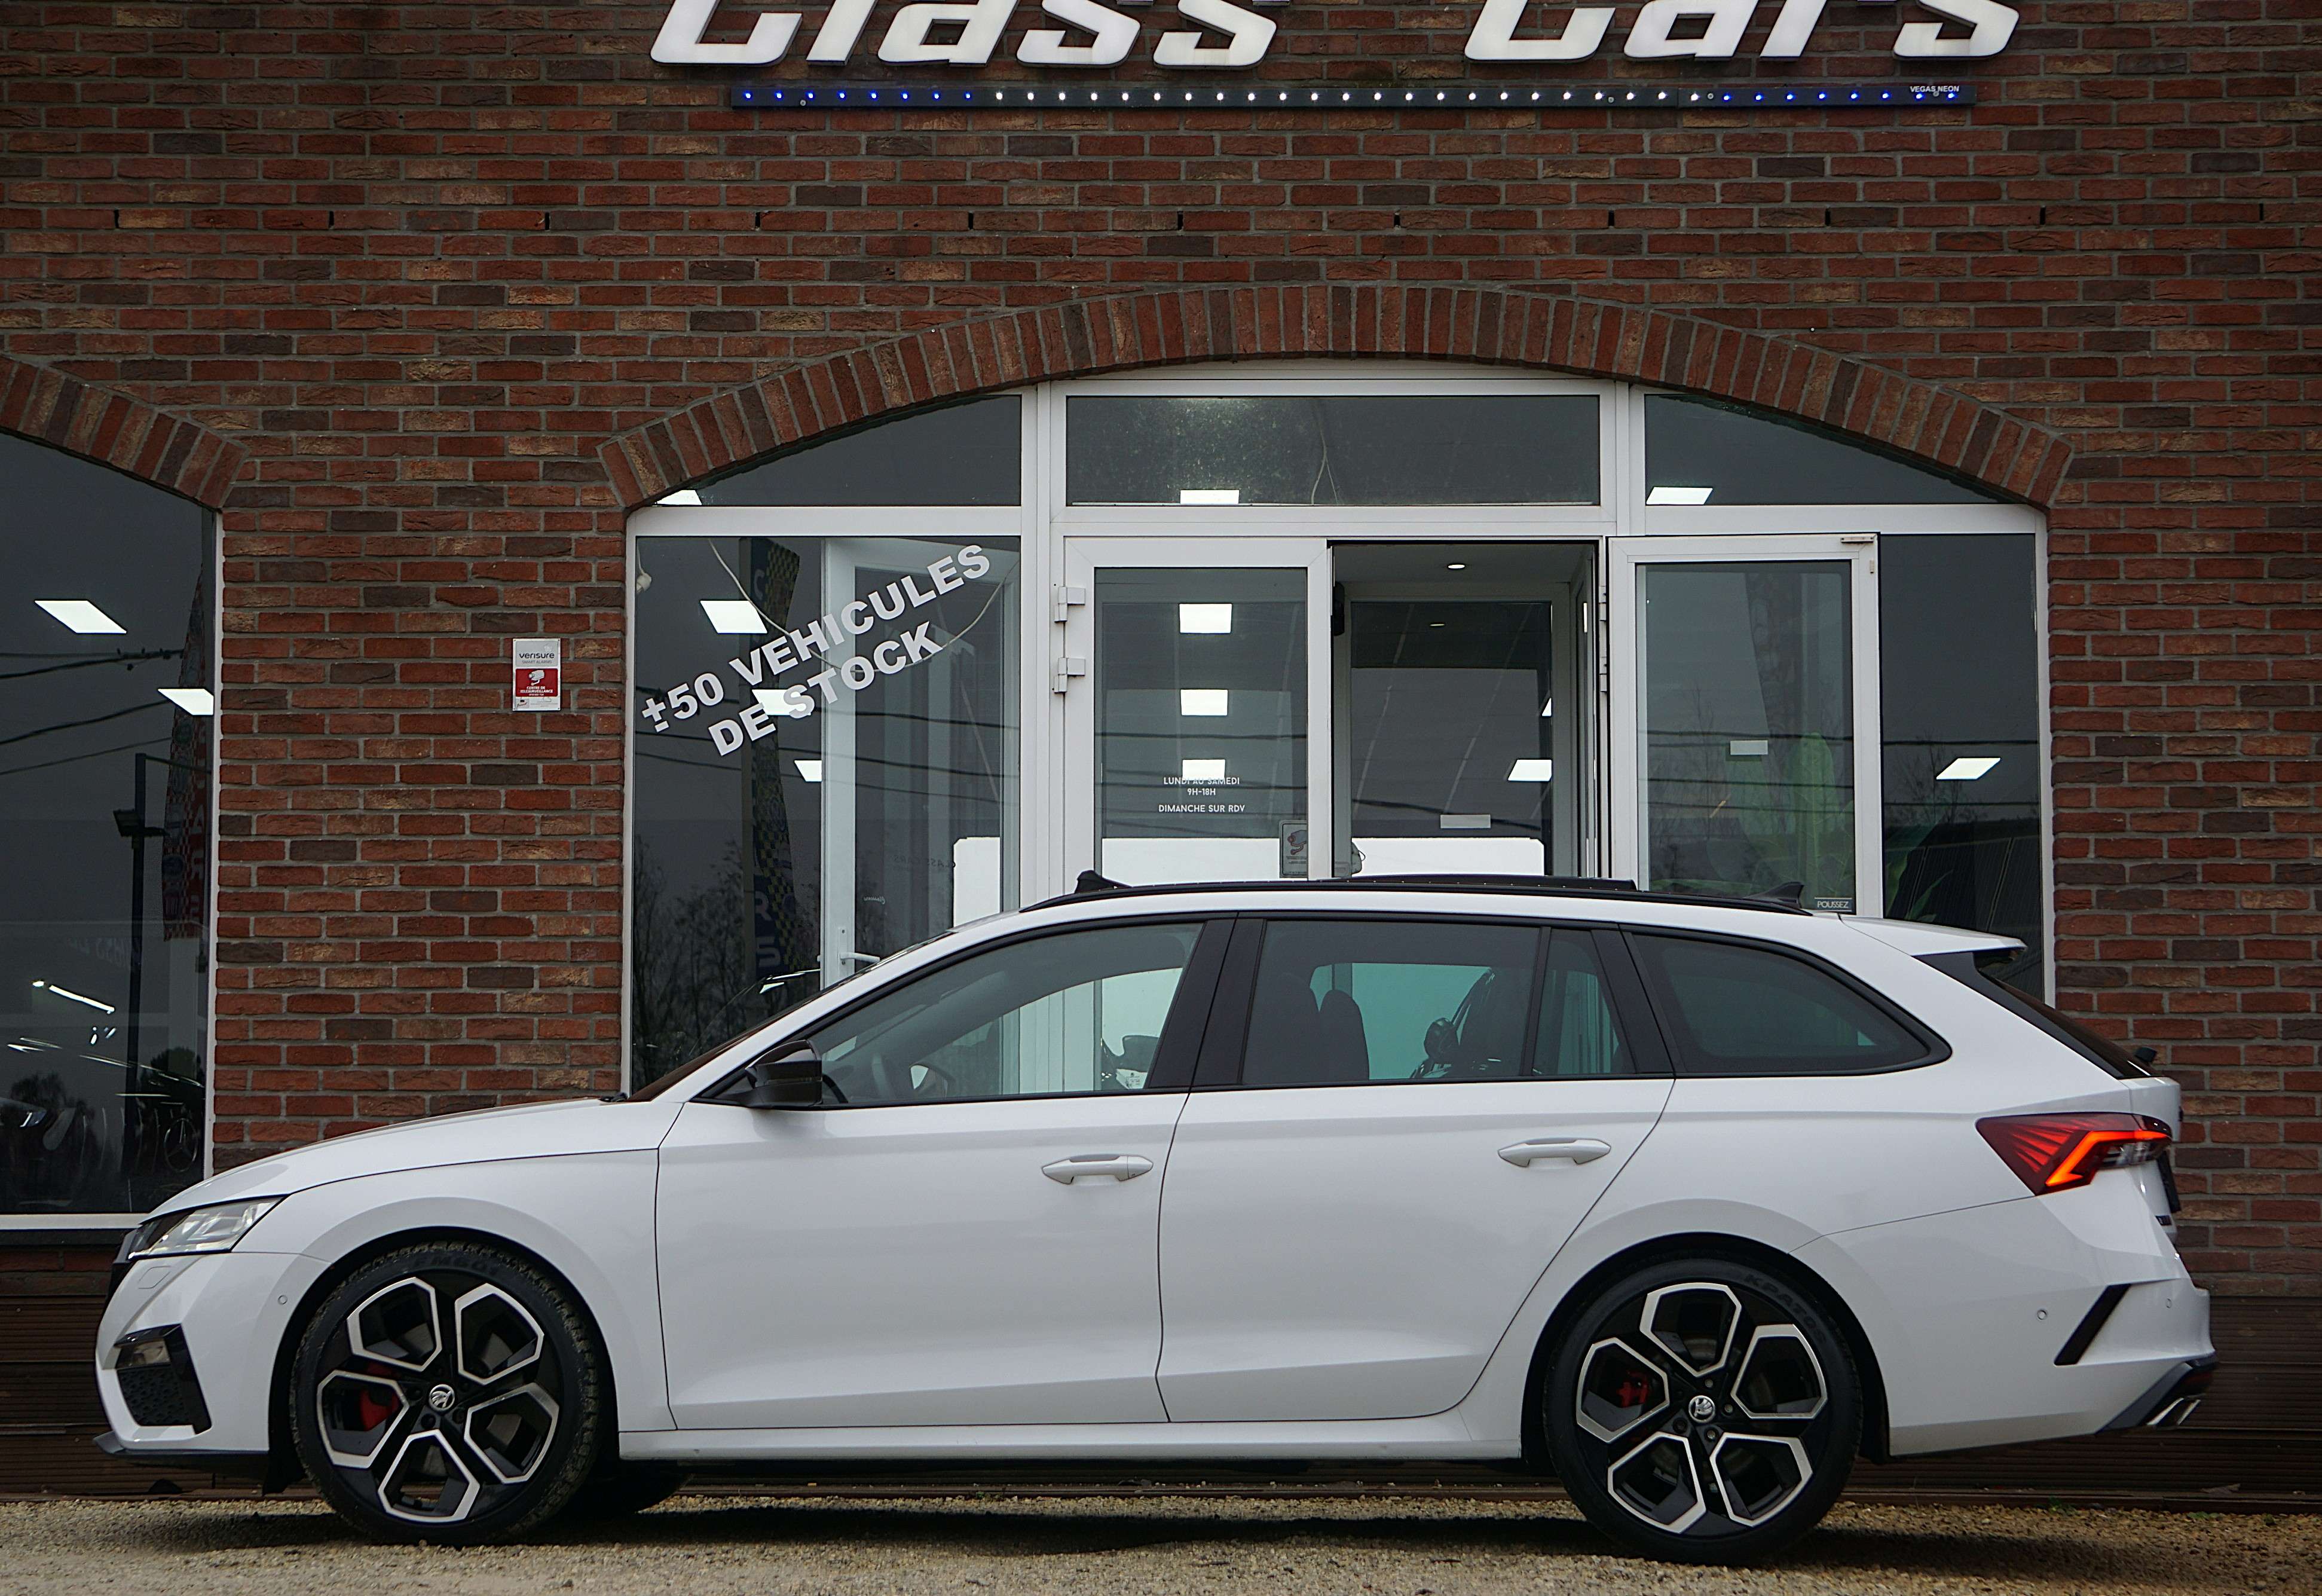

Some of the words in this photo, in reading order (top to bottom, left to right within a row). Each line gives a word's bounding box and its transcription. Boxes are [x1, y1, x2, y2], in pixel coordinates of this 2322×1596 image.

[729, 545, 990, 686] VEHICULES
[708, 702, 776, 757] DE
[782, 620, 944, 720] STOCK
